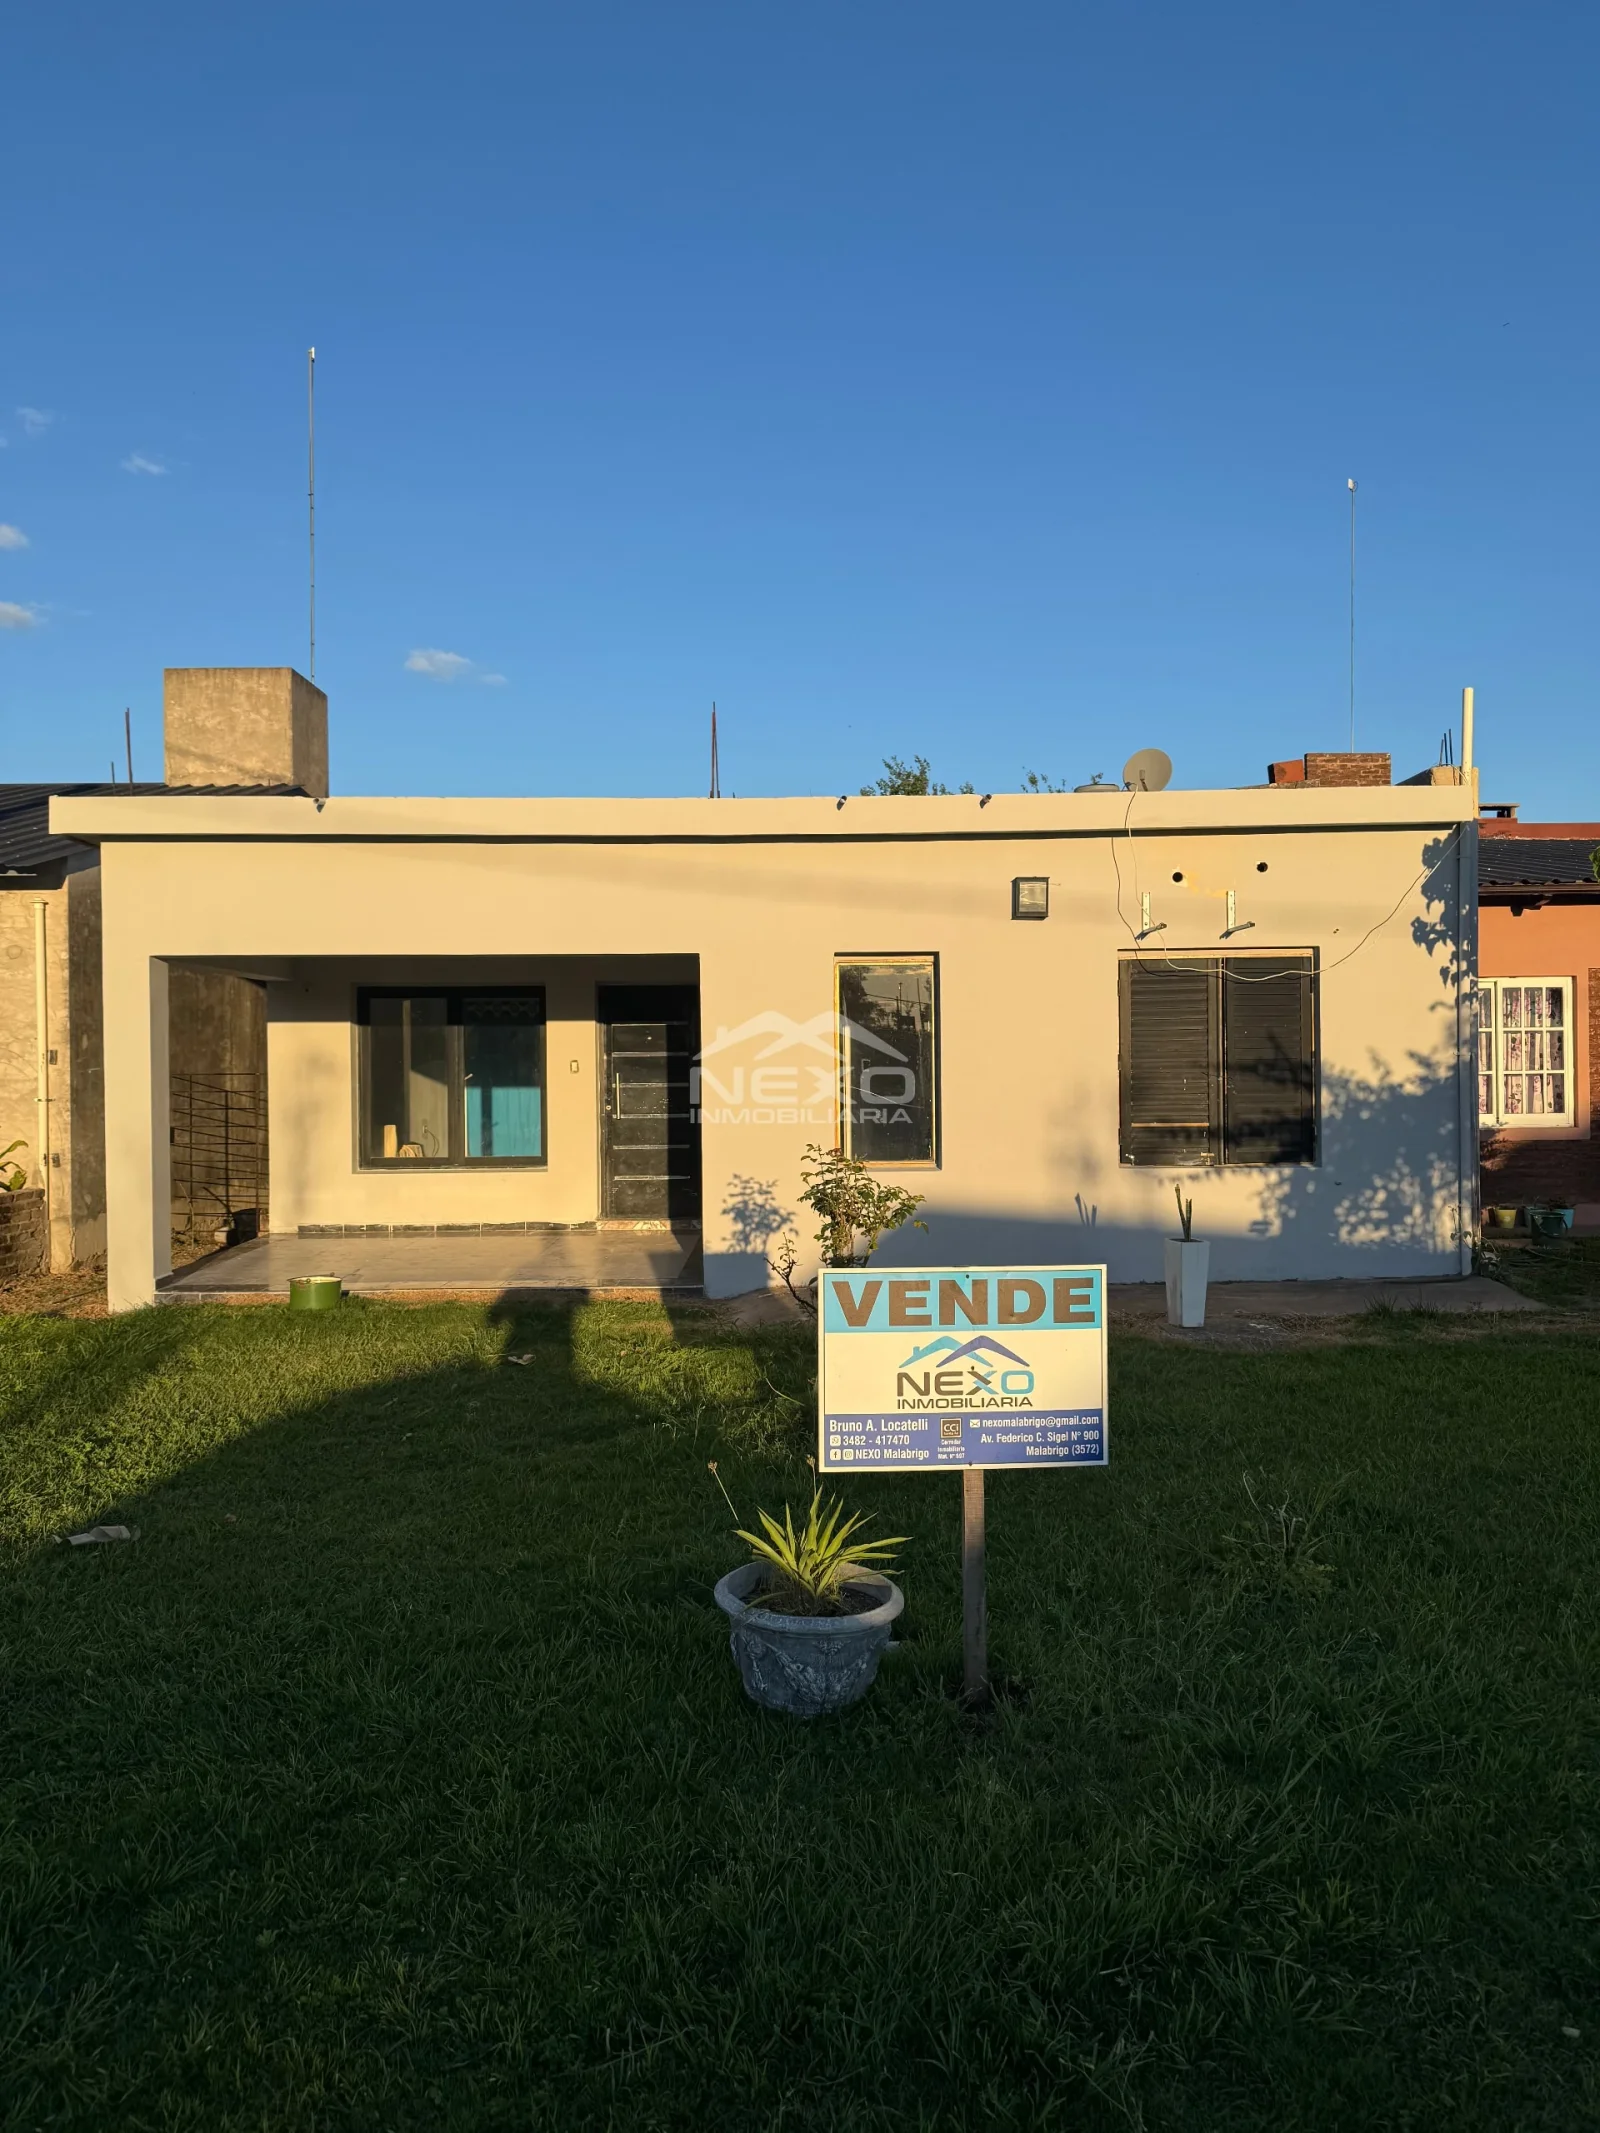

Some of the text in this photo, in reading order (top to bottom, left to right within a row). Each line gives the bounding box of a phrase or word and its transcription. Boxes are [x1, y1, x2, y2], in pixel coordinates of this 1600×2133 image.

[831, 1277, 1095, 1327] VENDE
[896, 1370, 1035, 1397] NEXO
[897, 1396, 1033, 1410] INMOBILIARIA
[829, 1418, 928, 1432] Bruno A. Locatelli
[982, 1416, 1099, 1429] nexomalabrigo@gmail.com
[843, 1435, 866, 1445] 3482
[875, 1435, 910, 1445] 417470
[981, 1433, 994, 1444] Av.
[996, 1432, 1034, 1443] Federico
[1036, 1432, 1044, 1442] C.
[1047, 1431, 1068, 1443] Sigel
[1083, 1430, 1099, 1440] 900
[855, 1448, 930, 1460] NEXO Malabrigo
[1026, 1444, 1099, 1457] Malabrigo (3572)
